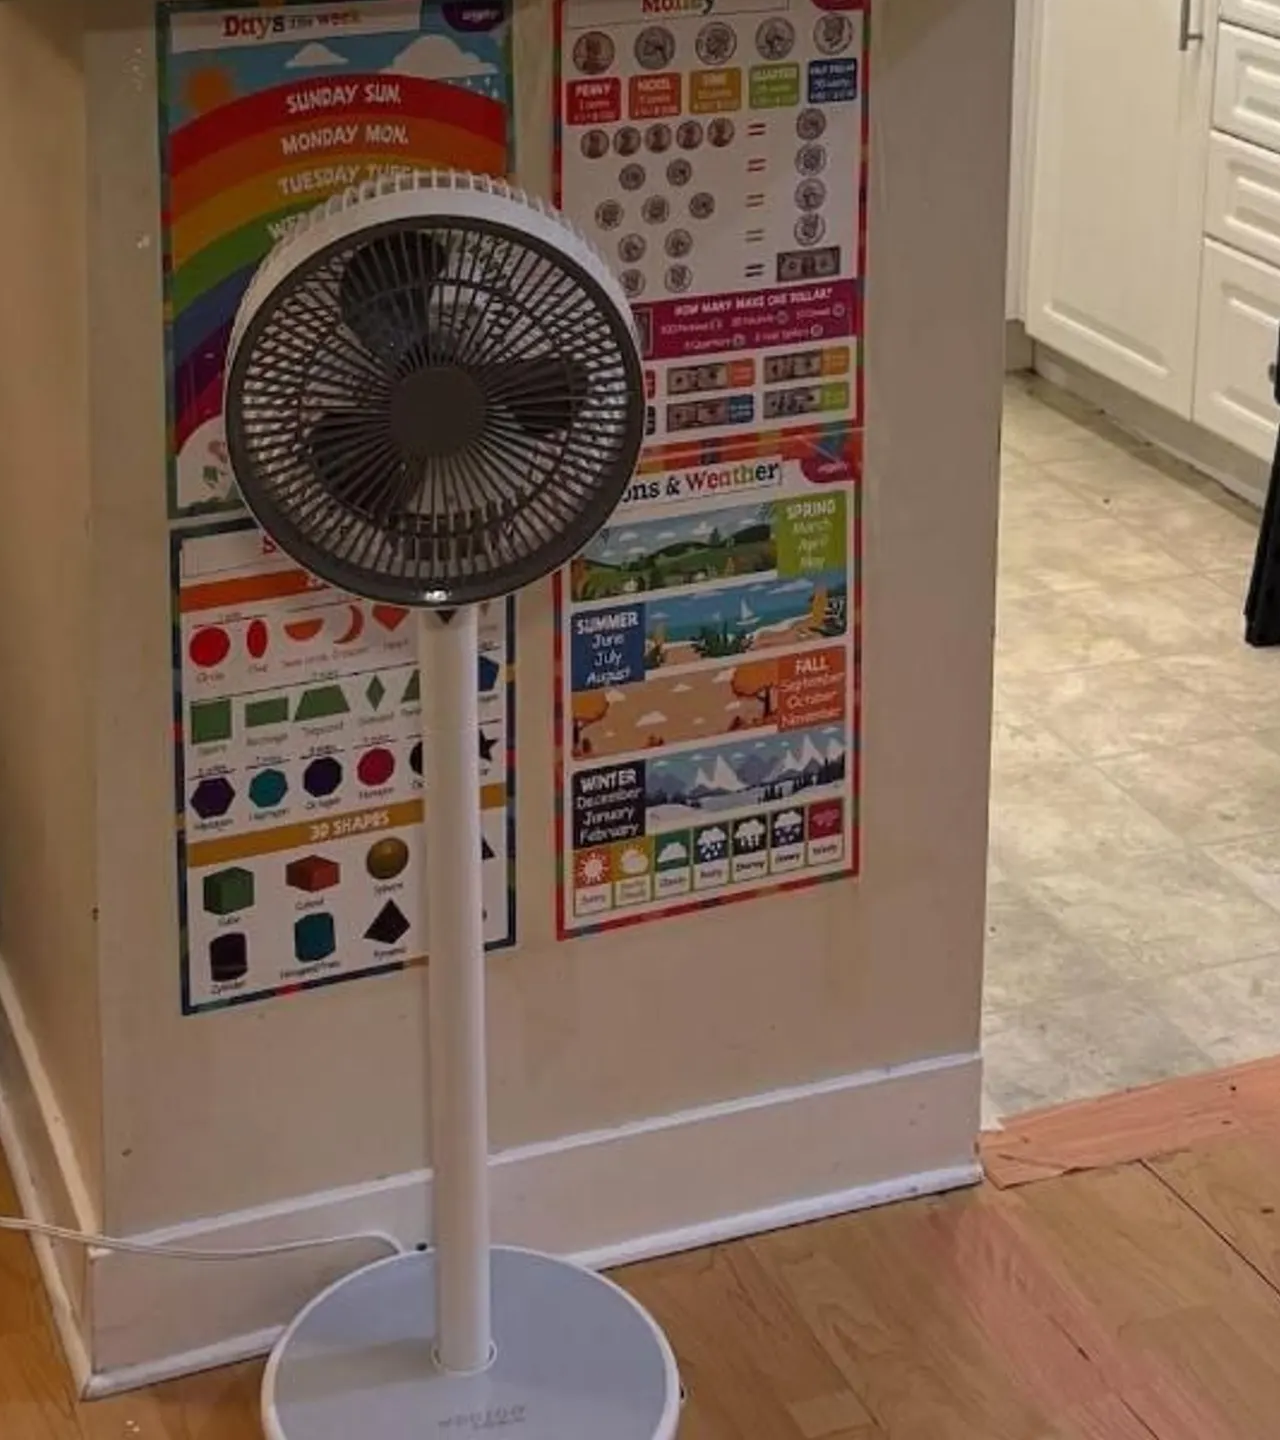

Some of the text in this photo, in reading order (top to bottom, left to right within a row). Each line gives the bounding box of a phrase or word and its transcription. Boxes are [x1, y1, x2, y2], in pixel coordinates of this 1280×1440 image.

[222, 14, 286, 41] Days
[285, 82, 403, 115] SUNDAY SUN.
[575, 82, 611, 98] PENNY
[280, 123, 410, 156] MONDAY MON.
[277, 164, 361, 195] TUESDAY
[665, 474, 681, 497] &
[685, 462, 780, 492] Weather
[786, 498, 836, 520] SPRING
[577, 611, 640, 635] SUMMER
[591, 633, 625, 649] June
[594, 649, 623, 667] July
[795, 656, 831, 675] FALL
[579, 768, 637, 794] WINTER
[577, 787, 643, 810] December
[332, 809, 391, 837] SHAPES
[583, 805, 637, 827] January
[580, 823, 640, 845] February
